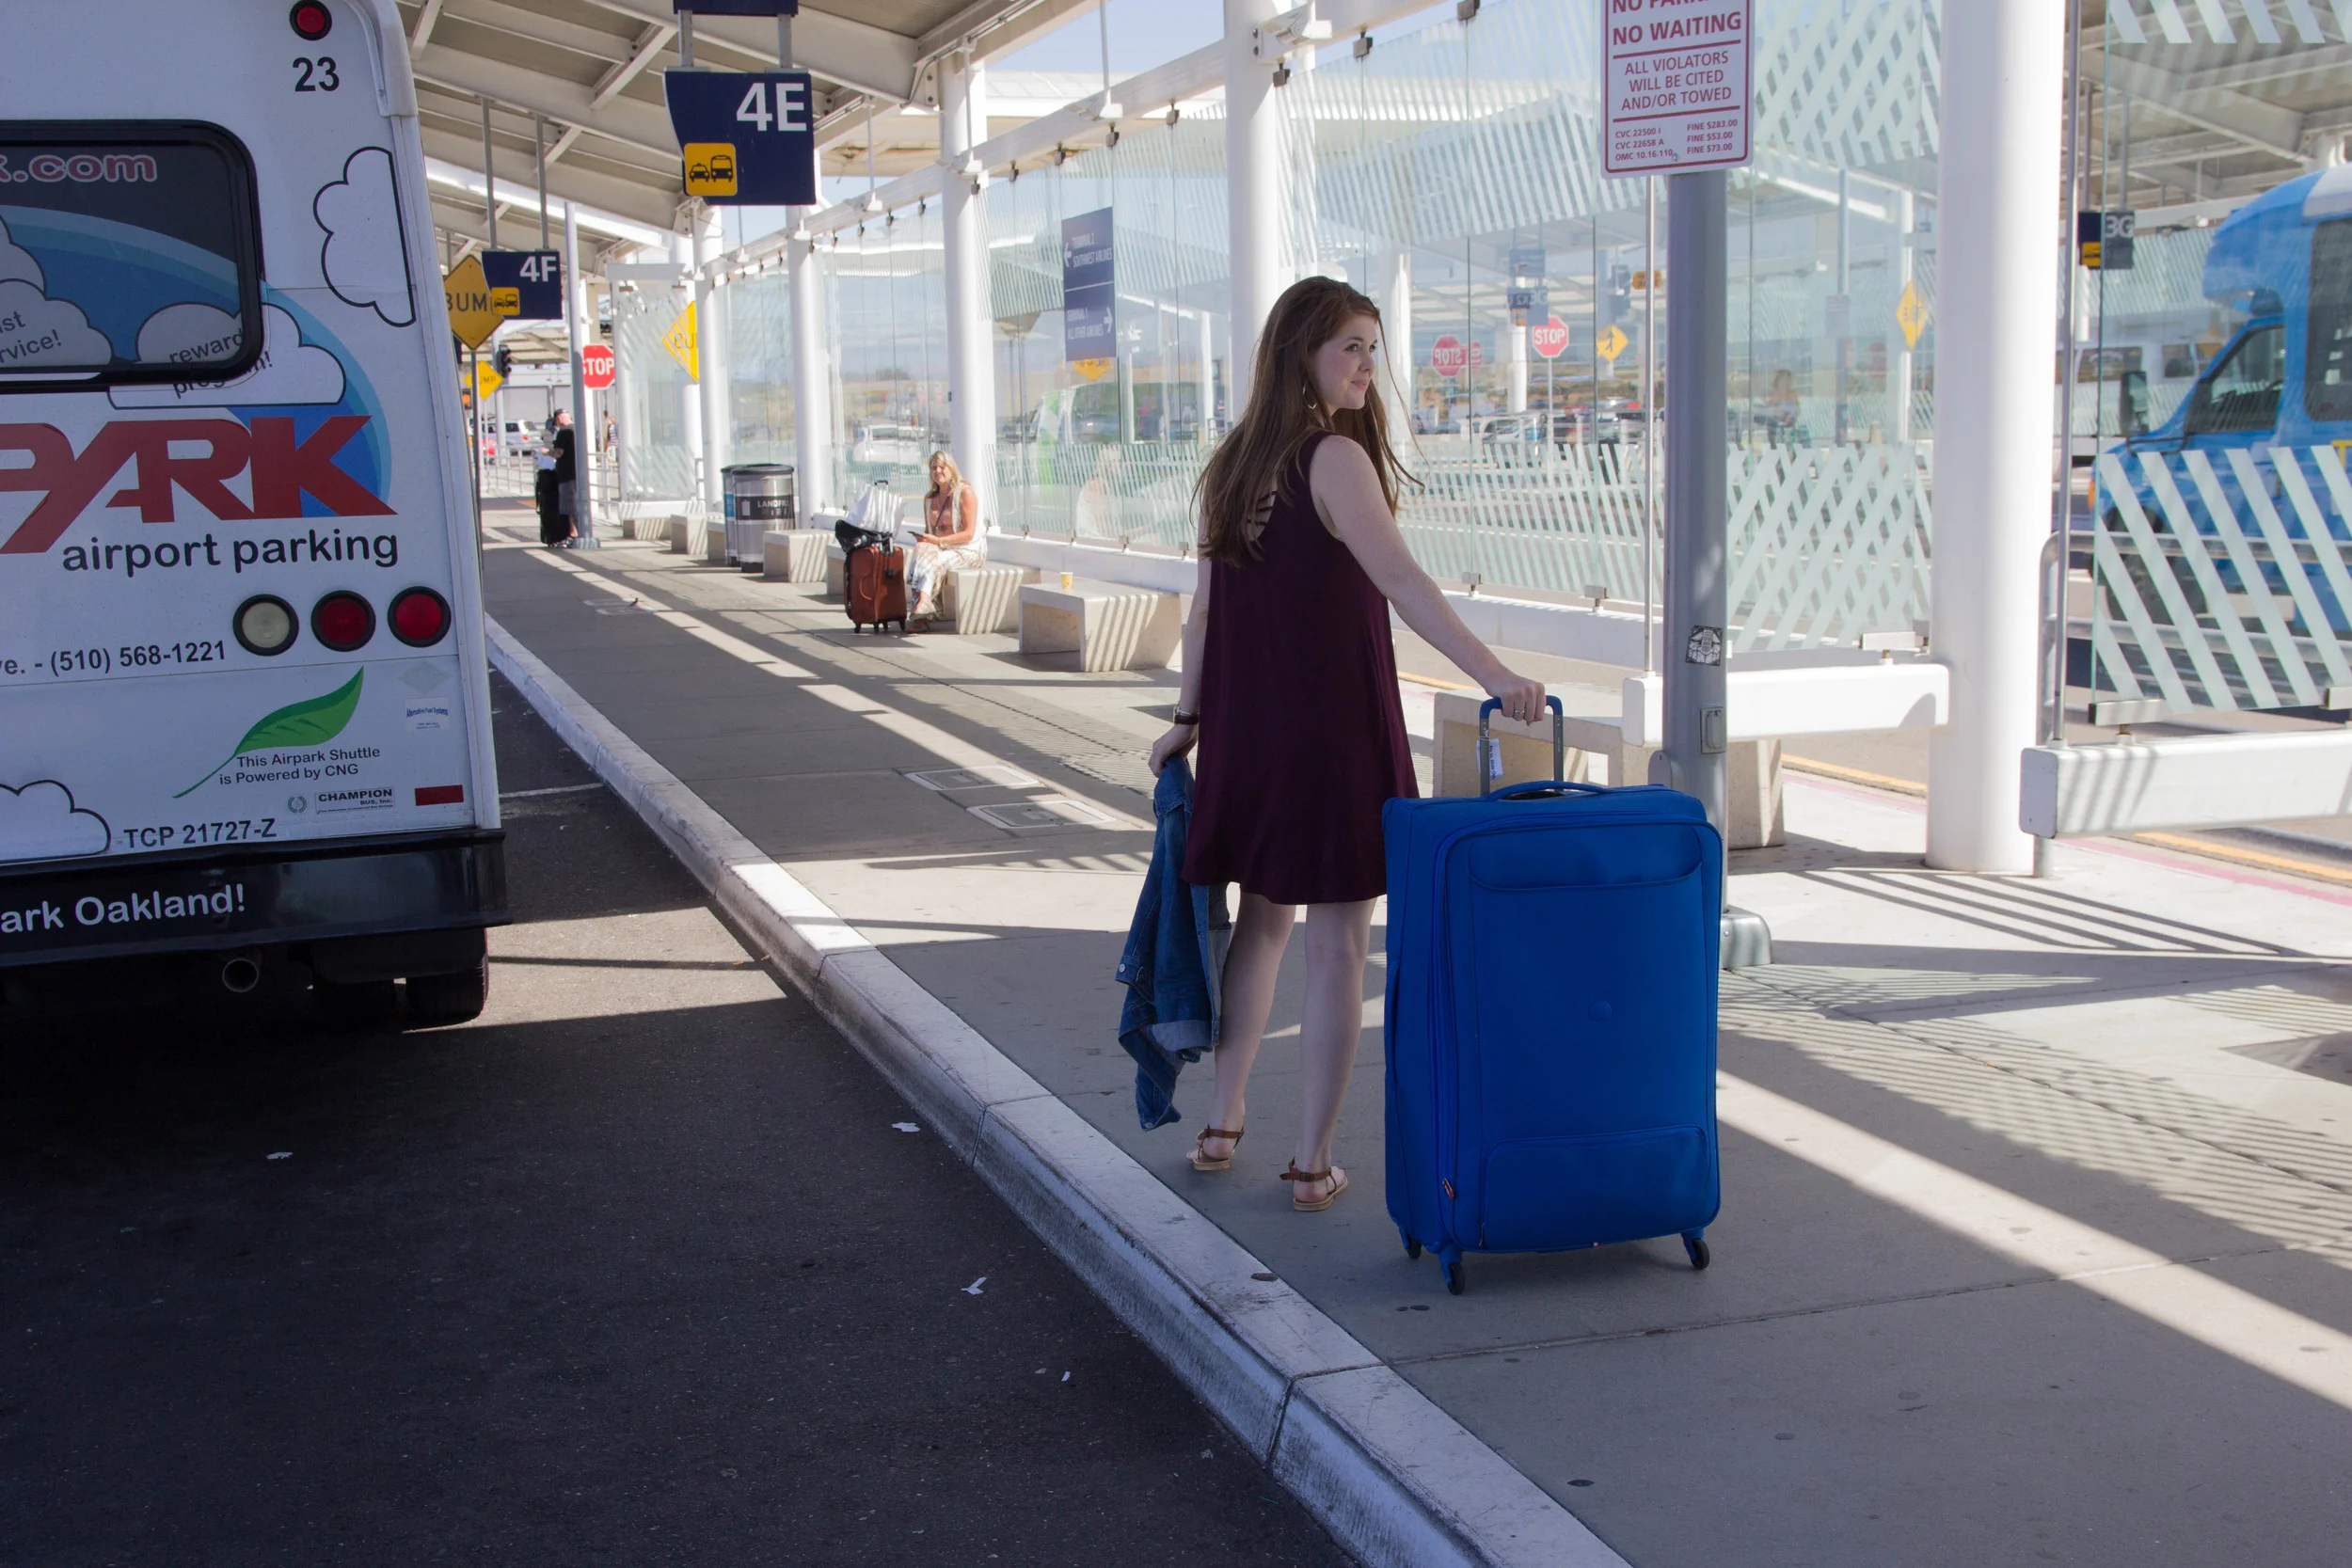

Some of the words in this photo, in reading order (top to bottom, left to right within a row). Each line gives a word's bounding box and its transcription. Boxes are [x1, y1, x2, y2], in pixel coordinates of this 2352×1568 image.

[1613, 25, 1643, 45] NO
[1650, 12, 1740, 40] WAITING
[293, 56, 340, 92] 23
[1625, 61, 1648, 75] ALL
[1653, 51, 1728, 71] VIOLATORS
[1629, 77, 1661, 92] WILL
[1665, 75, 1681, 88] BE
[1686, 70, 1724, 86] CITED
[736, 83, 807, 132] 4E
[1622, 94, 1676, 111] AND/OR
[1681, 87, 1731, 104] TOWED
[1615, 130, 1631, 138] CVC
[1633, 128, 1656, 136] 22500
[1687, 122, 1705, 131] FINE
[1707, 119, 1738, 129] $283.00
[1615, 141, 1631, 150] CVC
[1707, 132, 1733, 141] $53.00
[1615, 152, 1633, 161] OMC
[1707, 143, 1732, 152] $73.00
[2105, 214, 2134, 238] 3G
[519, 256, 557, 282] 4F
[0, 310, 26, 333] st
[1534, 329, 1565, 345] STOP
[62, 534, 221, 578] airport
[233, 529, 398, 574] parking
[0, 659, 25, 674] e.
[51, 649, 111, 677] (510)
[119, 640, 225, 668] 568-1221
[237, 755, 267, 768] This
[272, 751, 326, 768] Airpark
[329, 747, 380, 760] Shuttle
[219, 774, 231, 784] is
[236, 768, 300, 784] Powered
[304, 767, 321, 781] by
[325, 764, 359, 777] CNG
[319, 789, 392, 801] CHAMPION
[124, 826, 174, 847] TCP
[183, 818, 277, 845] 21727-Z
[0, 901, 64, 933] ark
[75, 883, 245, 926] Oakland!
